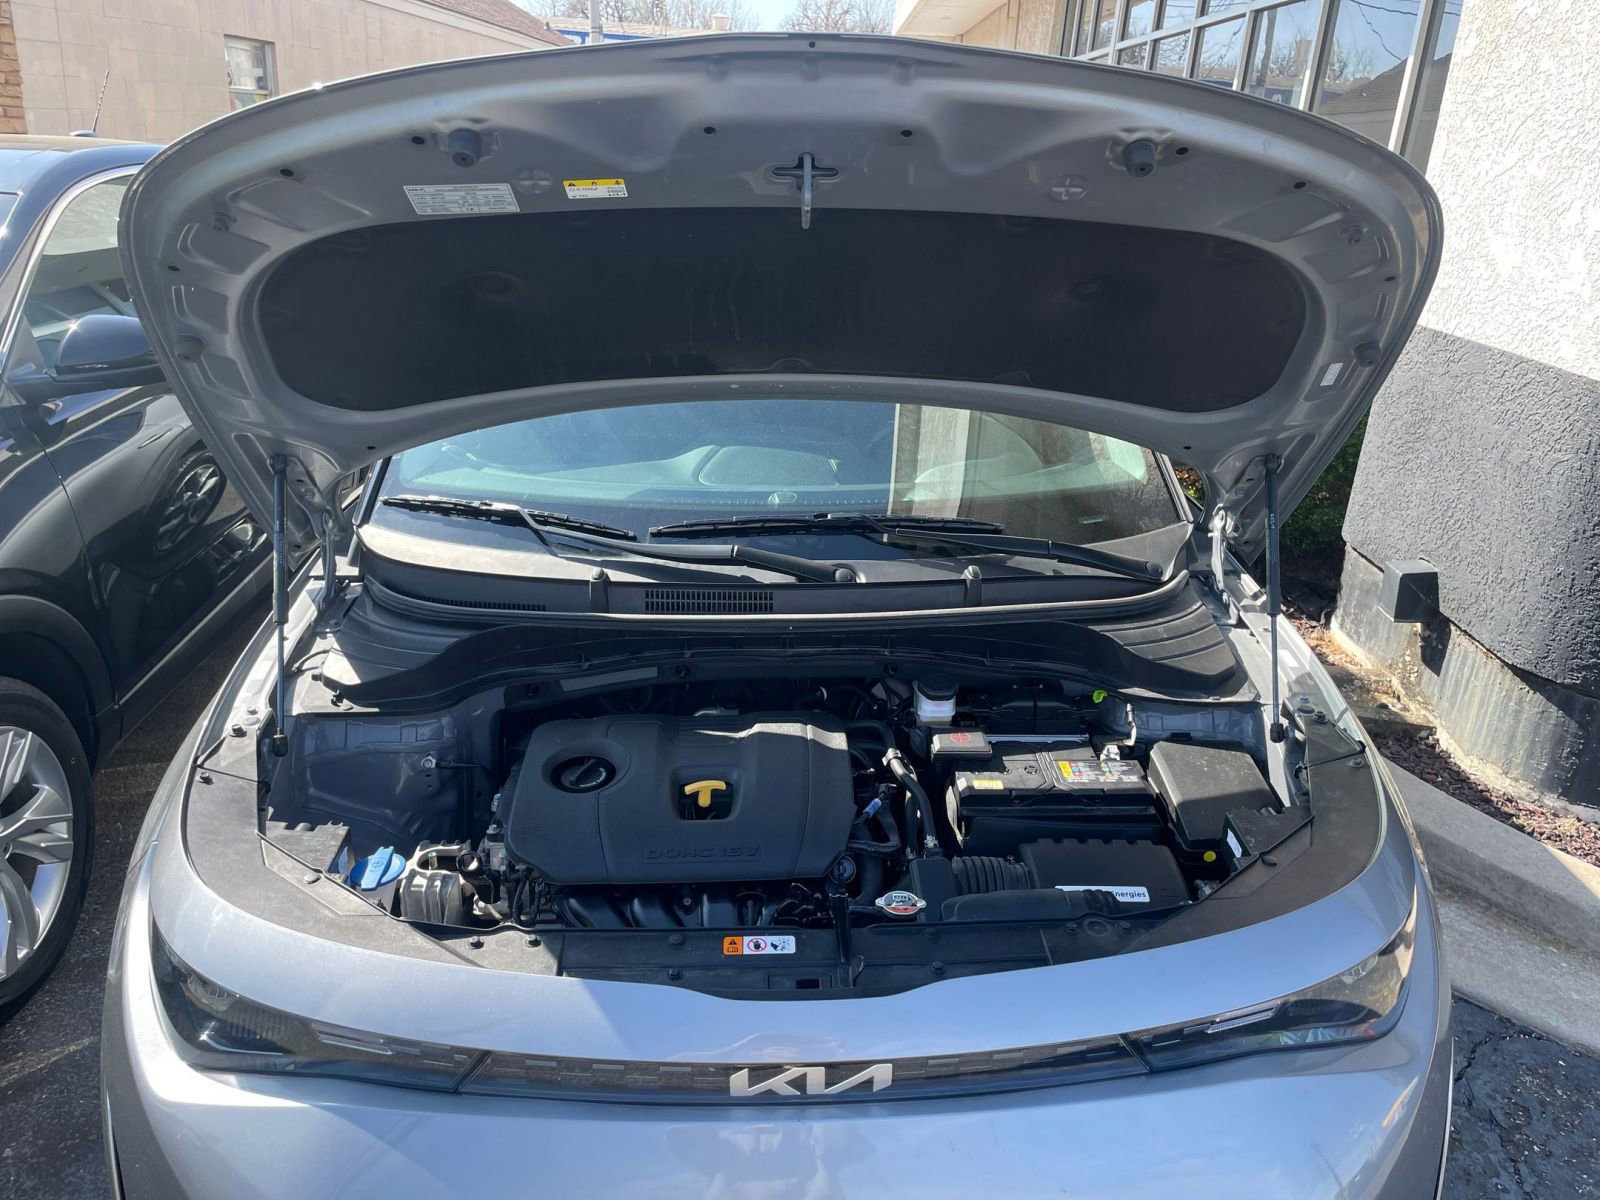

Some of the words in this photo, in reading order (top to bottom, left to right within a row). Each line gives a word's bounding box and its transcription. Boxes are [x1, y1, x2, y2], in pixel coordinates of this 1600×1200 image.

[645, 847, 714, 860] DOHC
[1113, 890, 1146, 898] nergies
[730, 1063, 892, 1096] KIA
